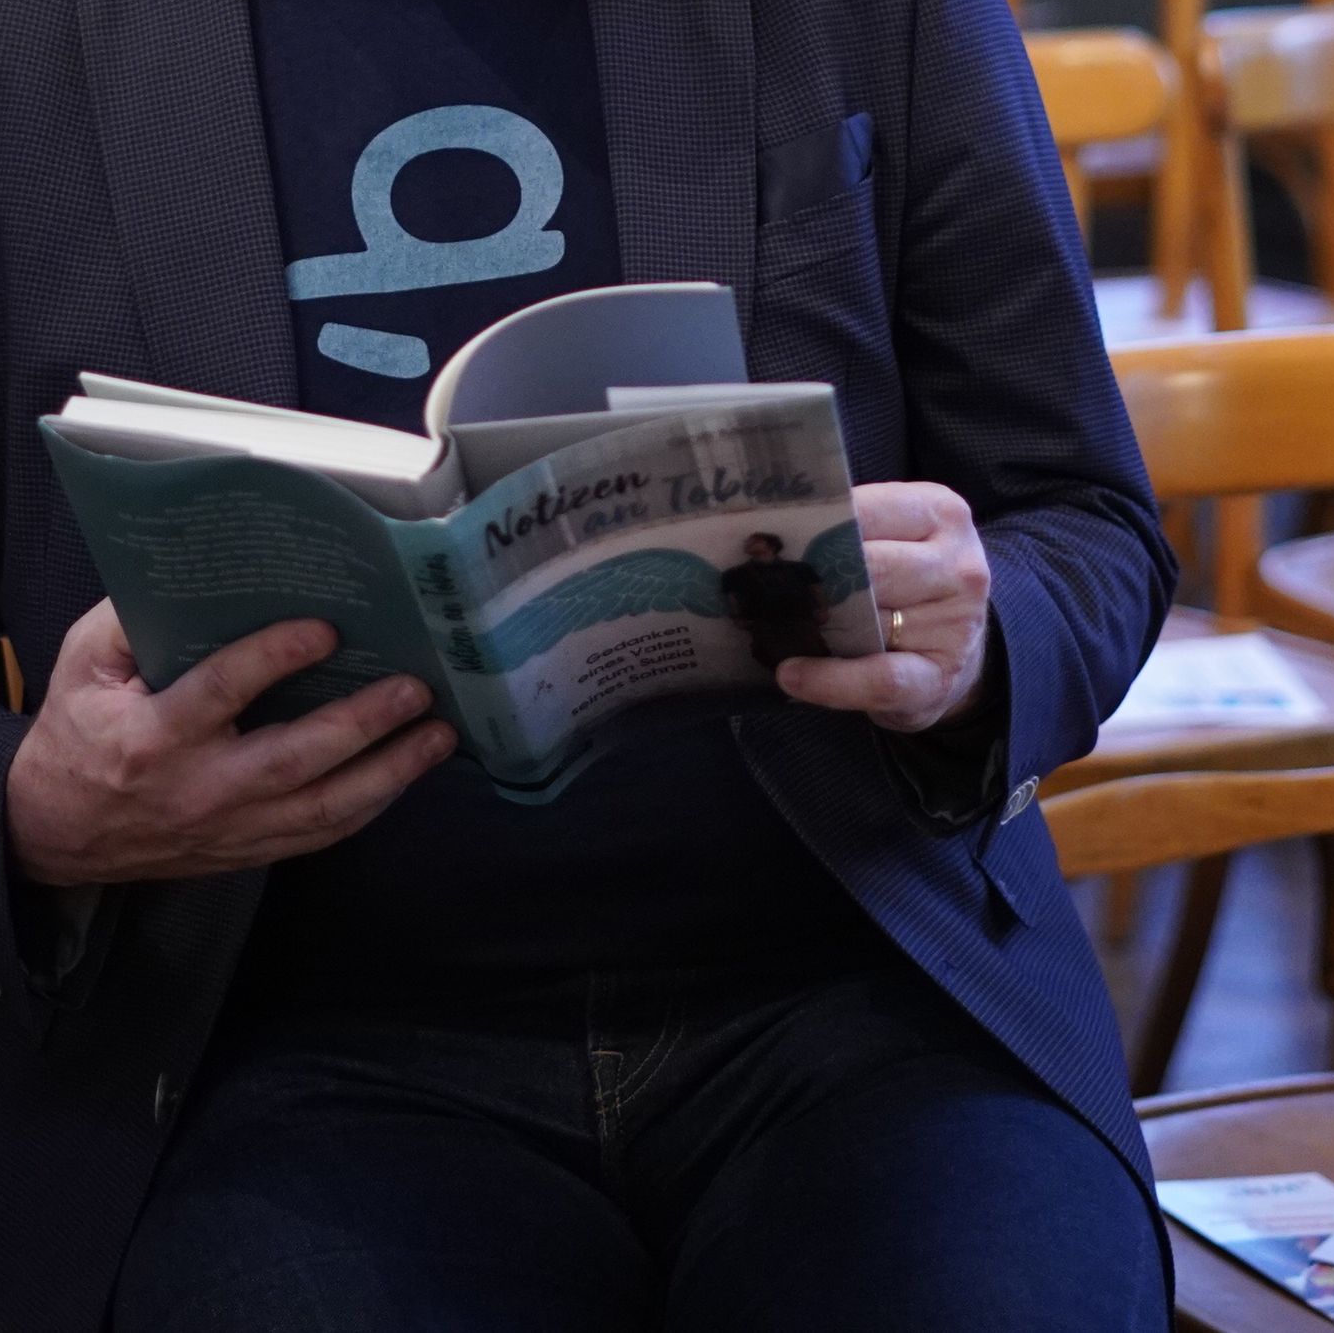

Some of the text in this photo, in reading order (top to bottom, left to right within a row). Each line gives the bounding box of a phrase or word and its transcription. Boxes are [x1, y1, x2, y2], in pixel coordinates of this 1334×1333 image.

[484, 469, 651, 559] Notizen
[581, 465, 817, 536] an Tobias
[577, 636, 693, 684] eines Vaters
[585, 625, 689, 664] Gedanken
[596, 647, 696, 687] zum Suizid
[570, 660, 699, 716] seines Sohnes
